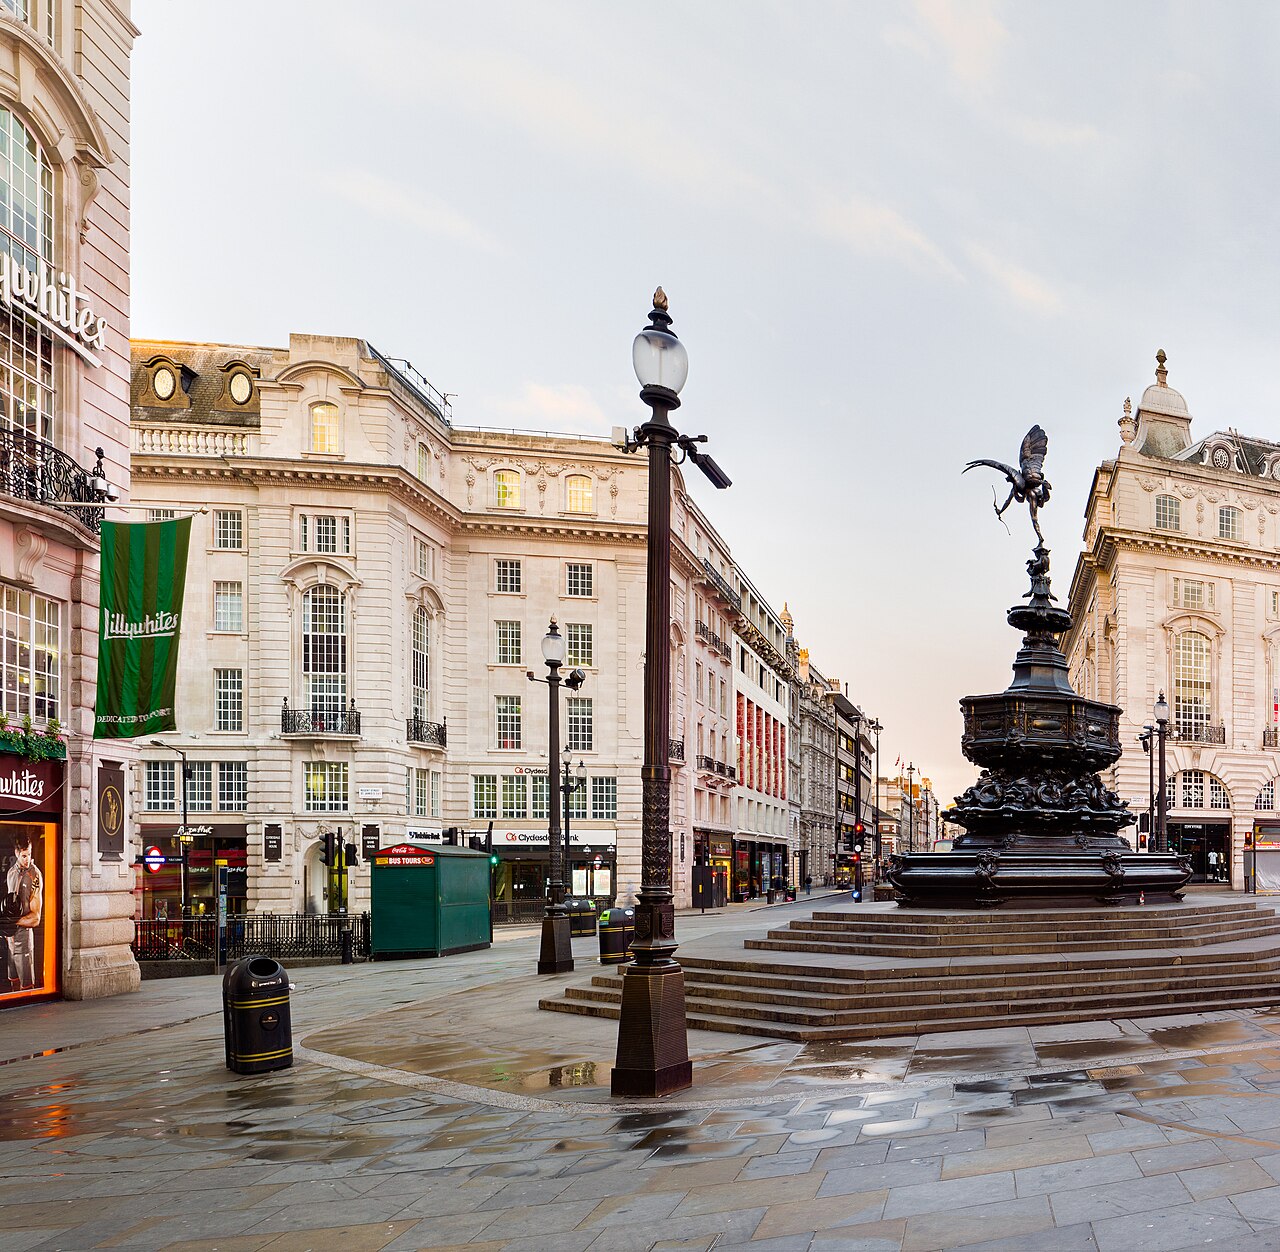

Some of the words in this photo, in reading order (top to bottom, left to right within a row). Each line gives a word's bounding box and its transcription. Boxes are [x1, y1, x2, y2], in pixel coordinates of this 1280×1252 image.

[104, 607, 178, 640] Lillywhites
[97, 715, 138, 724] DEDICATED
[388, 857, 401, 865] BUS
[402, 857, 422, 865] TOURS
